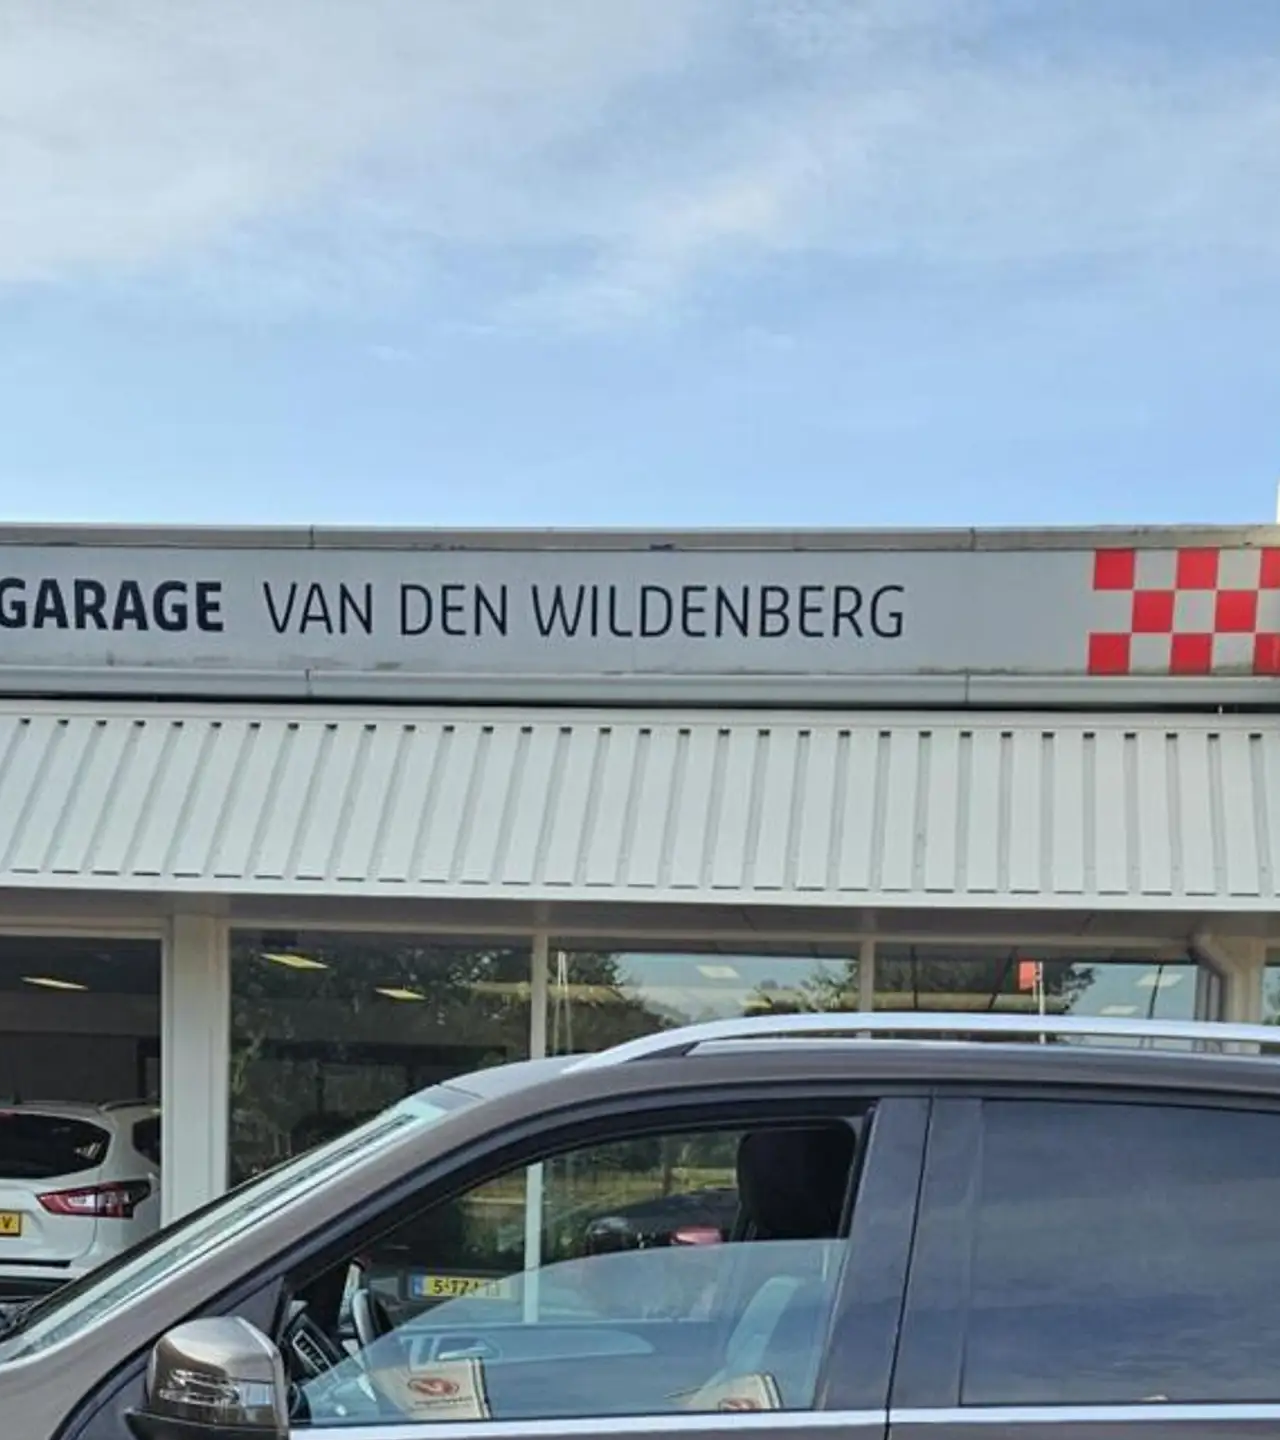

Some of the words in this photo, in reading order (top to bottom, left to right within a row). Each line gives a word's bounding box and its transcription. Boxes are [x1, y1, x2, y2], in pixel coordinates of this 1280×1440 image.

[262, 581, 374, 635] VAN
[399, 582, 508, 636] DEN
[531, 583, 906, 638] WILDENBERG
